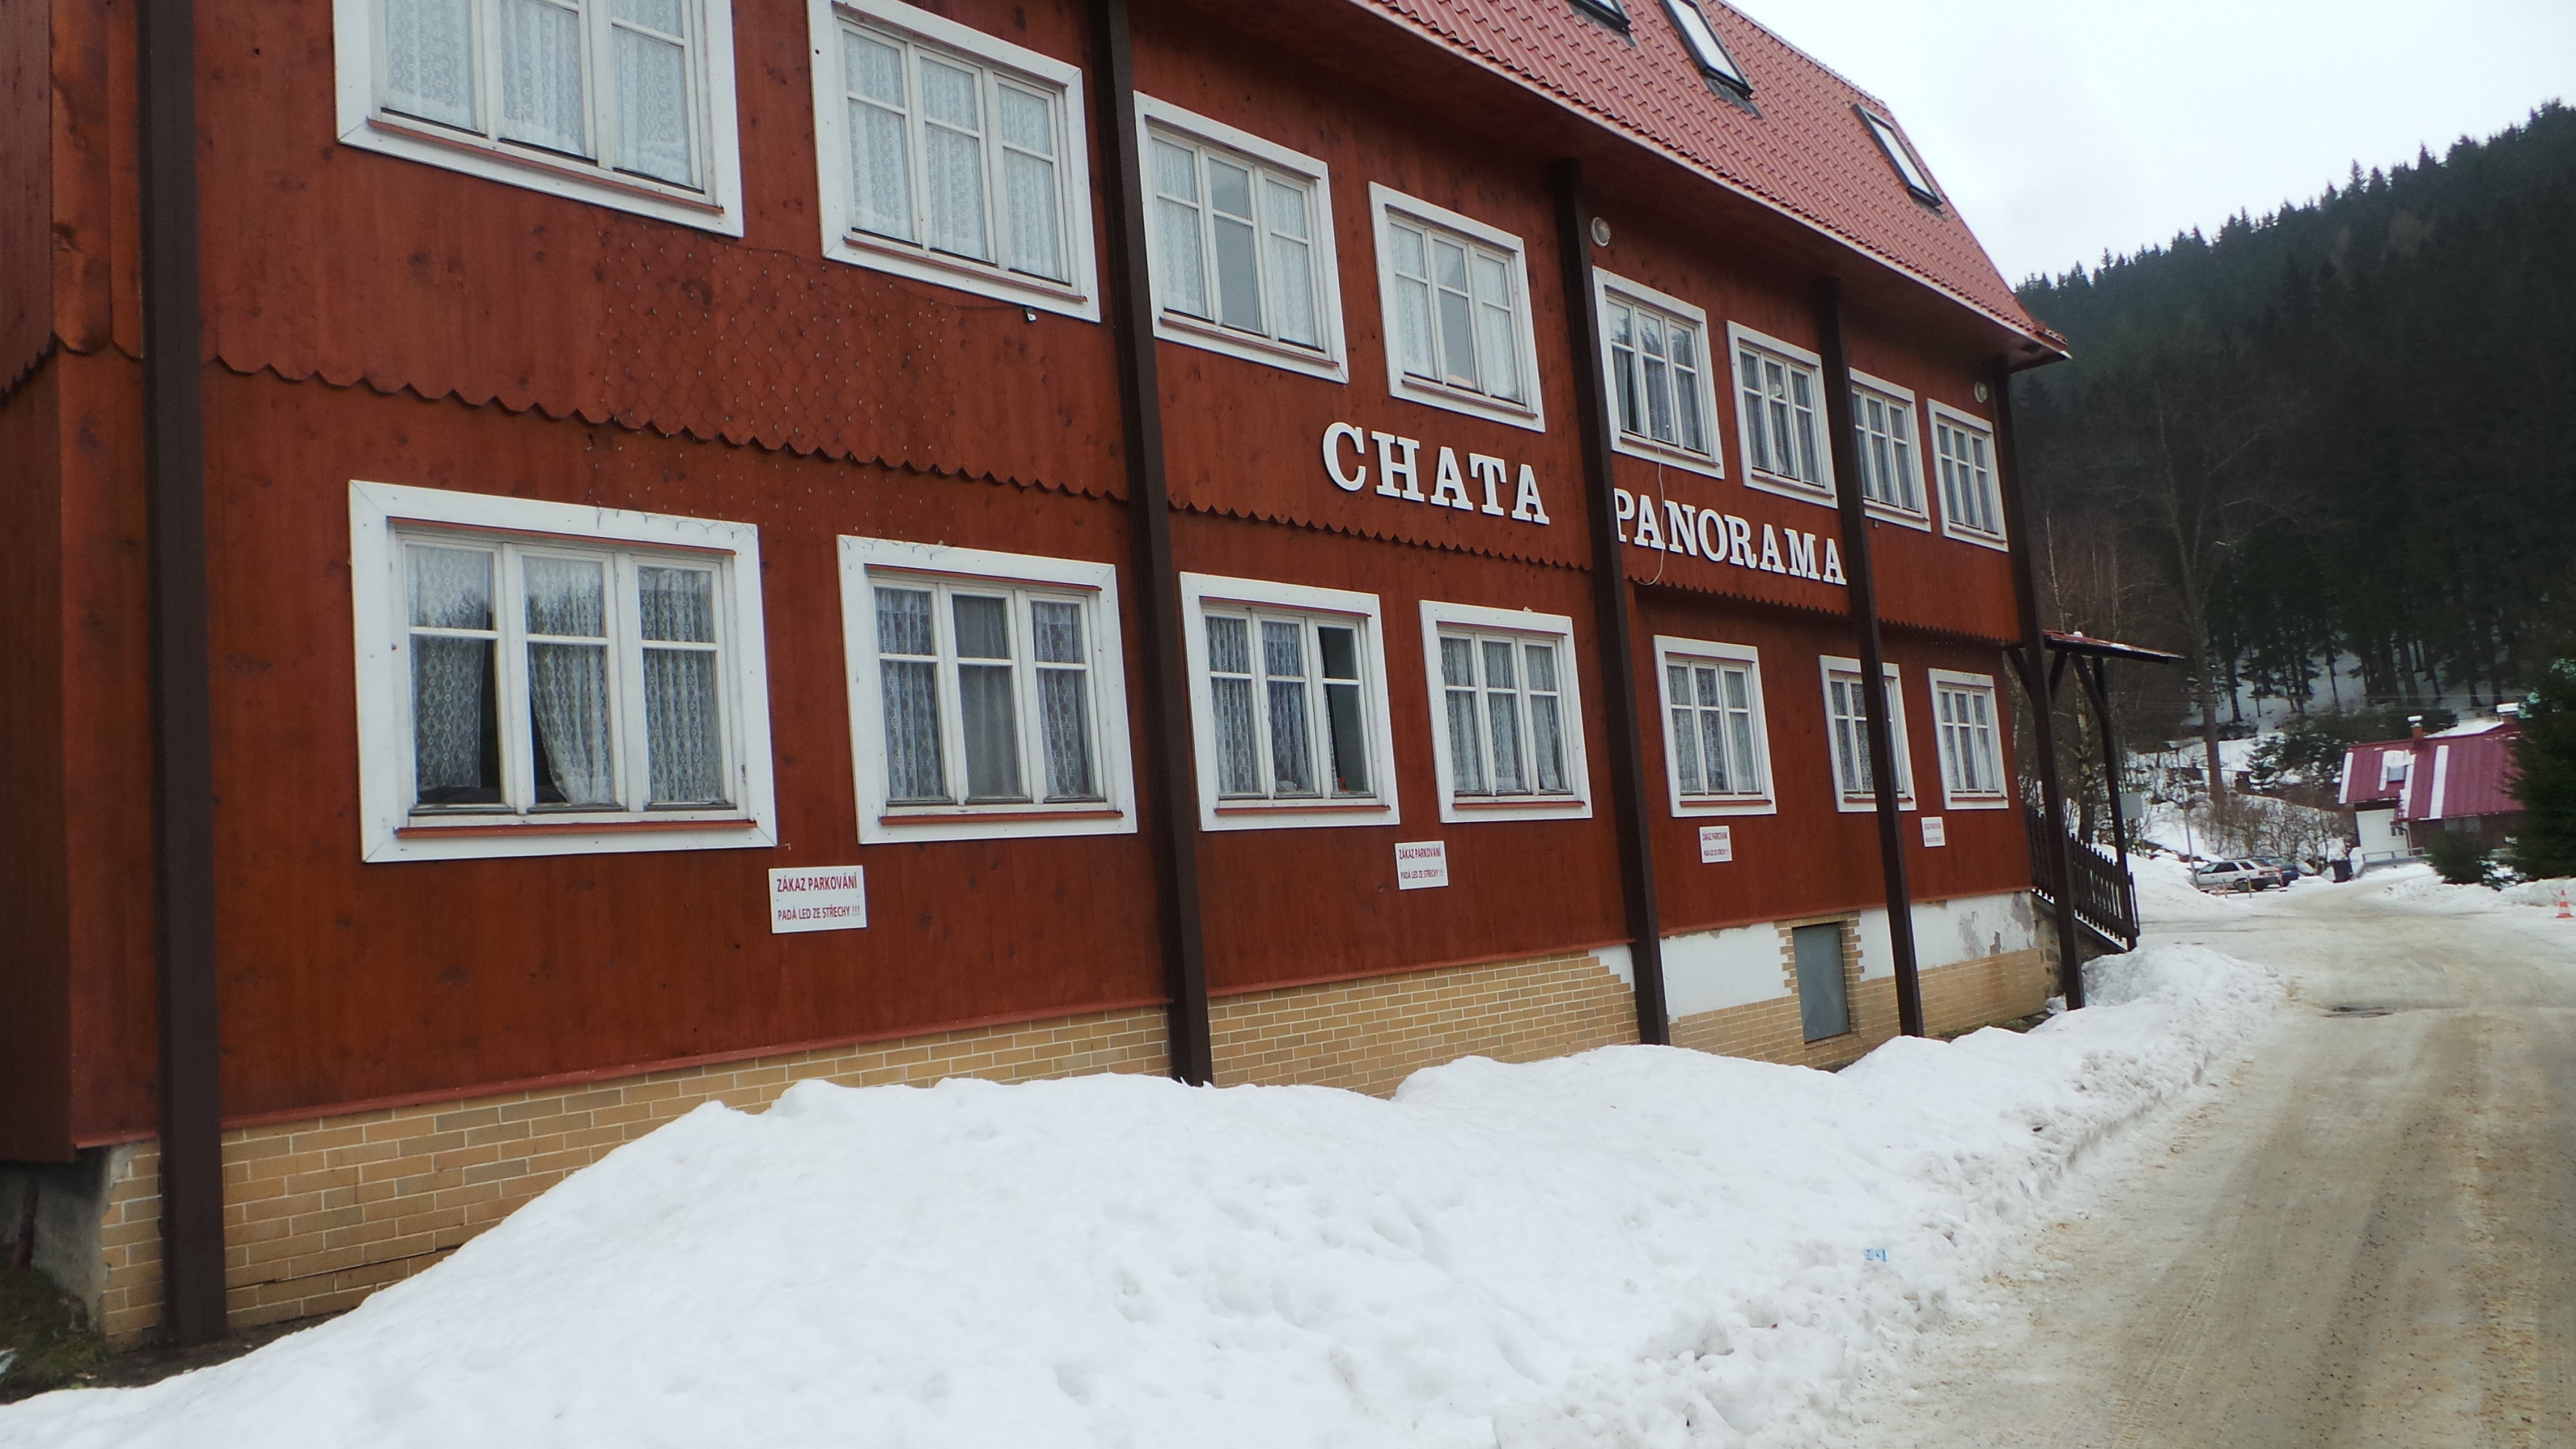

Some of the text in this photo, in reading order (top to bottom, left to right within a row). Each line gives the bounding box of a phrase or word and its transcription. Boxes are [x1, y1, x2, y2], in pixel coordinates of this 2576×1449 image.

[1322, 421, 1848, 585] CHATA PANORAMA
[1399, 845, 1441, 859] ZÁKAZ PARKOVÁNÍ
[777, 872, 858, 893] ZÁKAZ PARKOVÁNÍ
[778, 906, 797, 921] PADÁ
[799, 908, 811, 920] LED
[813, 907, 821, 918] ZE
[822, 904, 850, 918] STŘECHY
